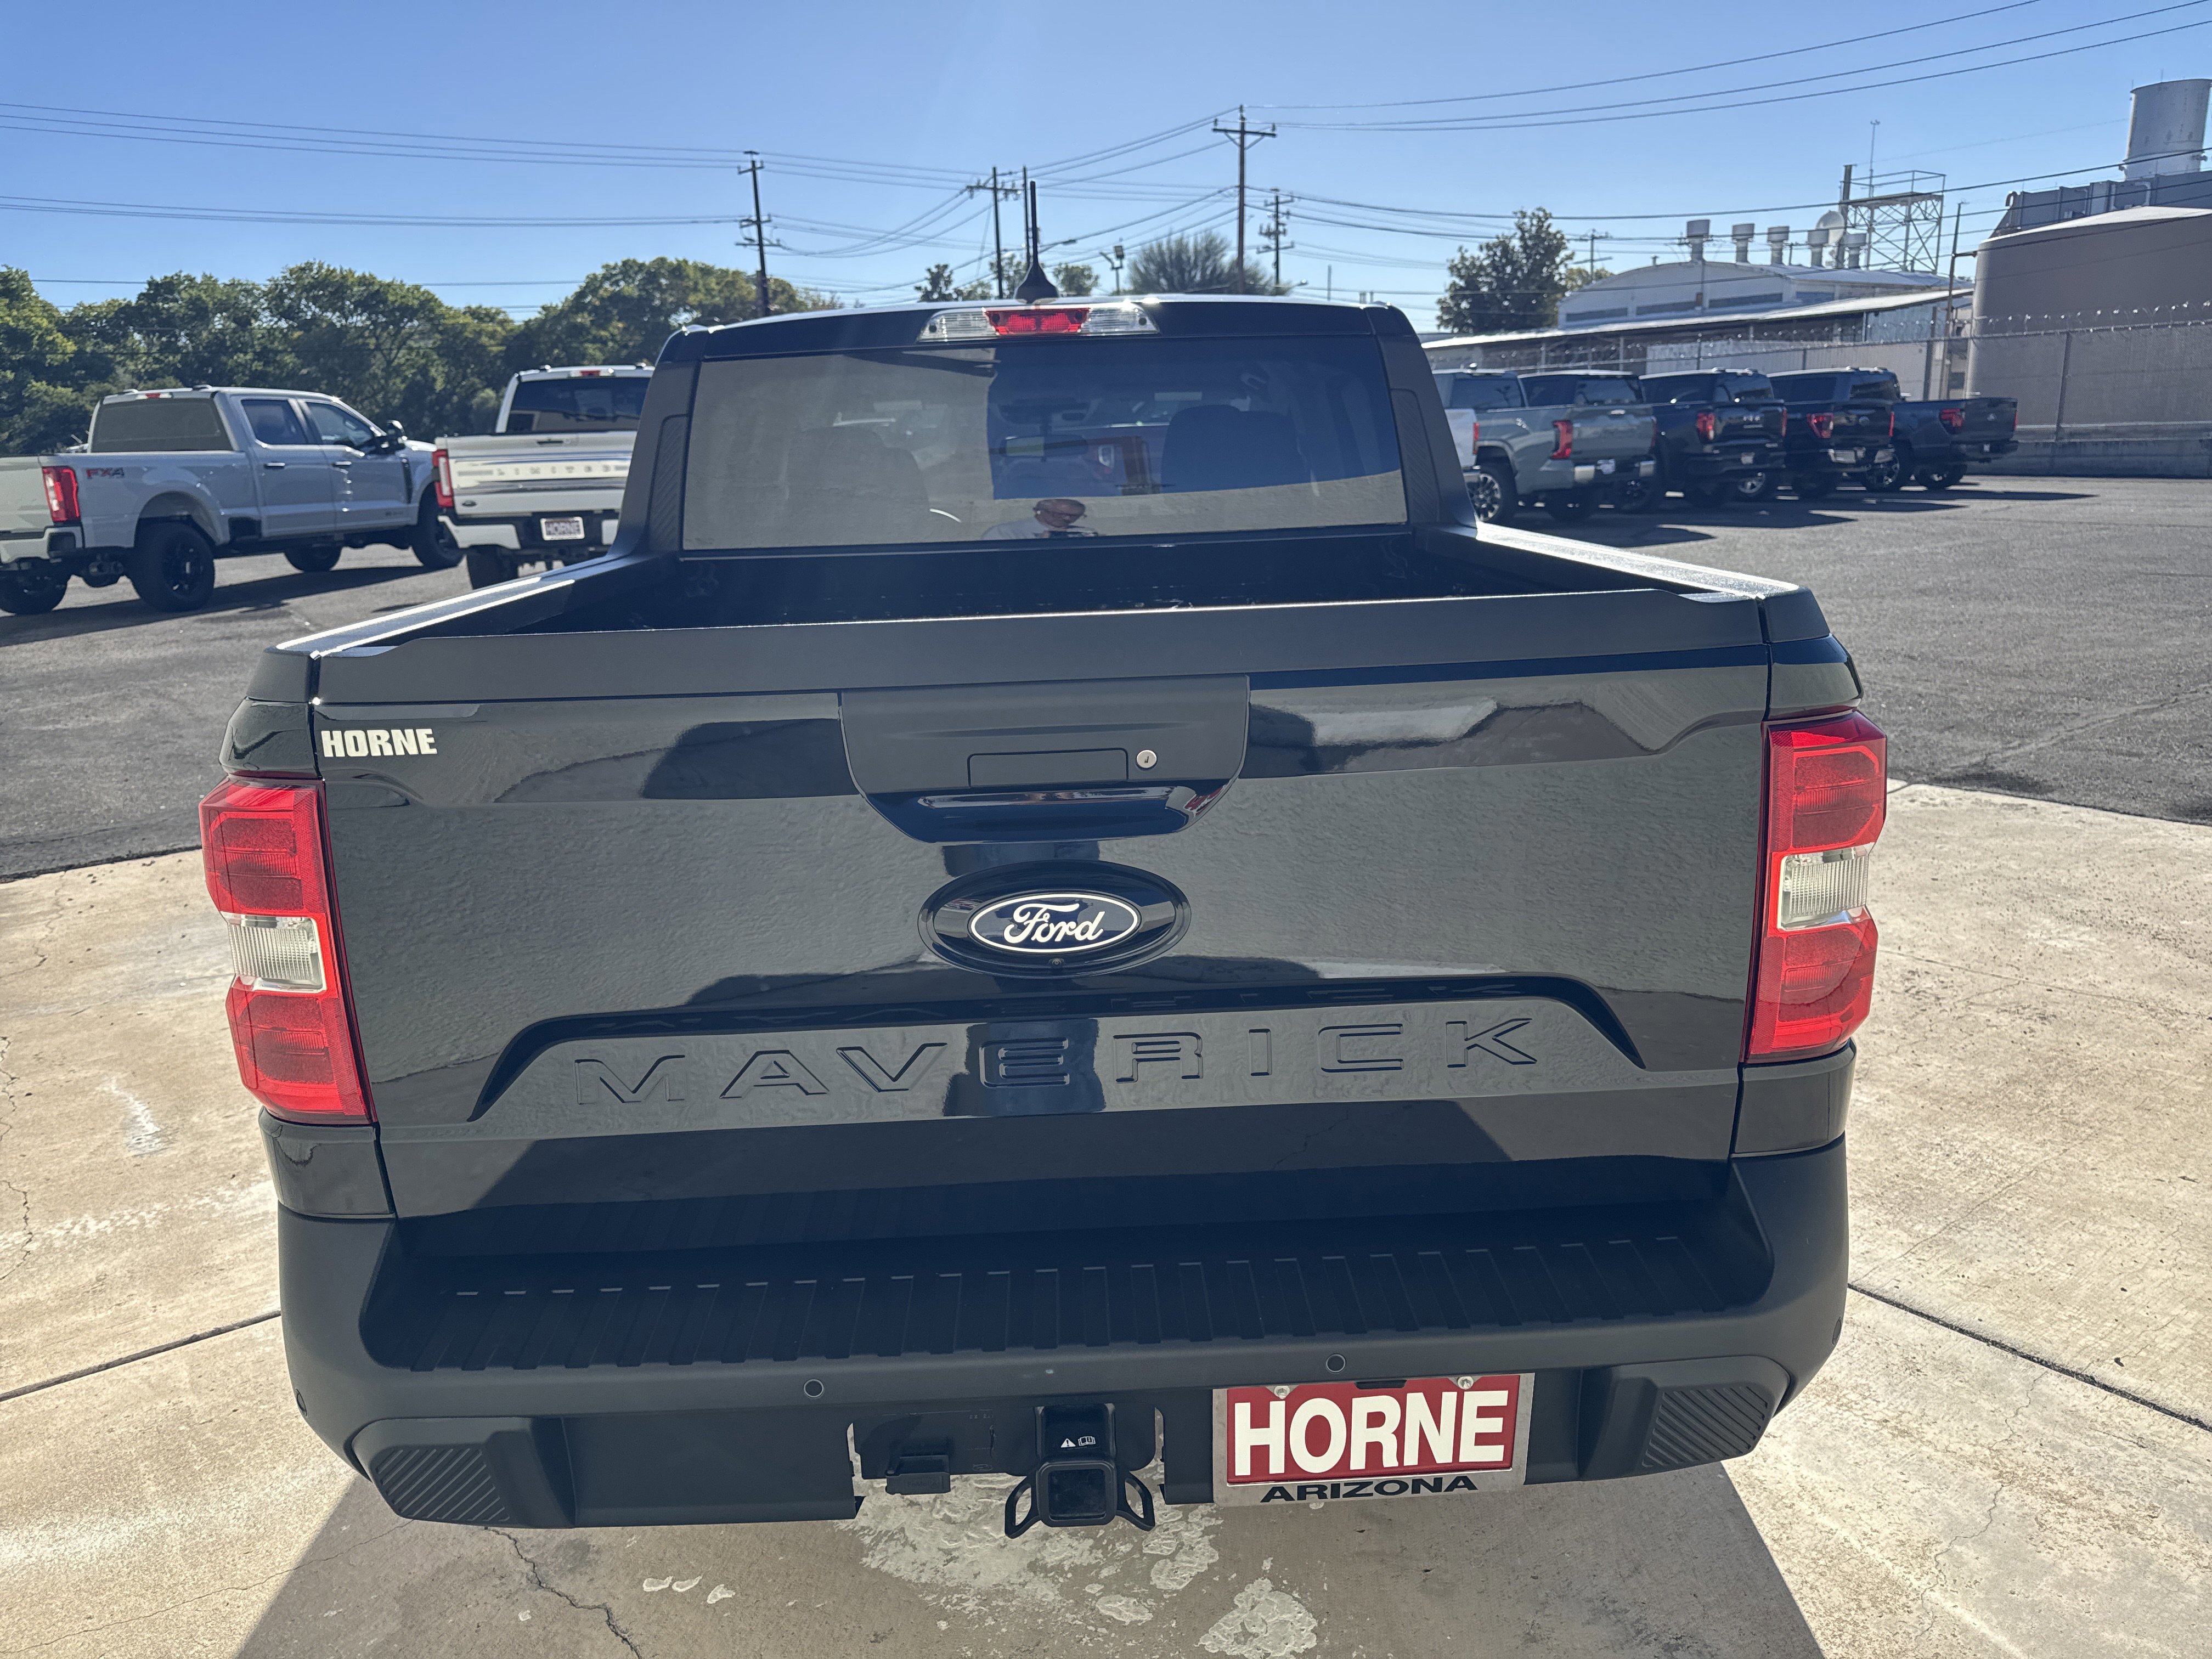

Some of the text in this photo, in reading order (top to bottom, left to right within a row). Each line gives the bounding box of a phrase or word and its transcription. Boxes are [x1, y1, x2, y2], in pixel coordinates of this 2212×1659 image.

[86, 467, 125, 479] FX4
[320, 728, 438, 758] HORNE
[1003, 902, 1106, 944] Ford
[574, 1017, 1538, 1105] MAVERICK
[1234, 1390, 1509, 1476] HORNE
[1260, 1475, 1479, 1503] ARIZONA
